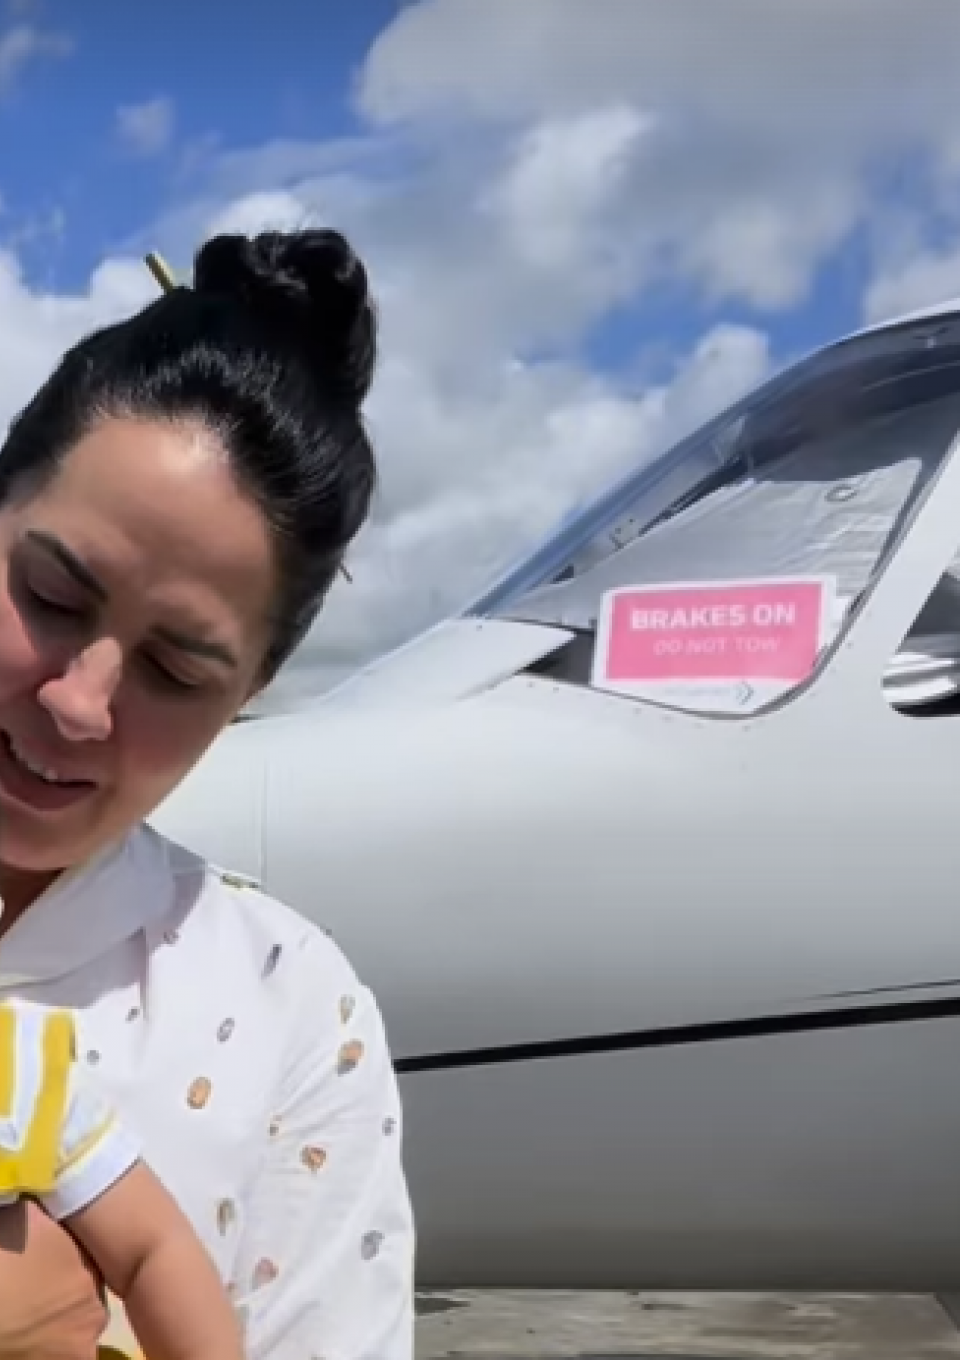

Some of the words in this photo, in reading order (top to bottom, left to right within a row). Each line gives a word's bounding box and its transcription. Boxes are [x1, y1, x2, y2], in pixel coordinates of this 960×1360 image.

[631, 606, 746, 630] BRAKES
[753, 601, 796, 626] ON
[654, 638, 683, 656] DO
[686, 636, 727, 655] NOT
[735, 636, 779, 653] TOW
